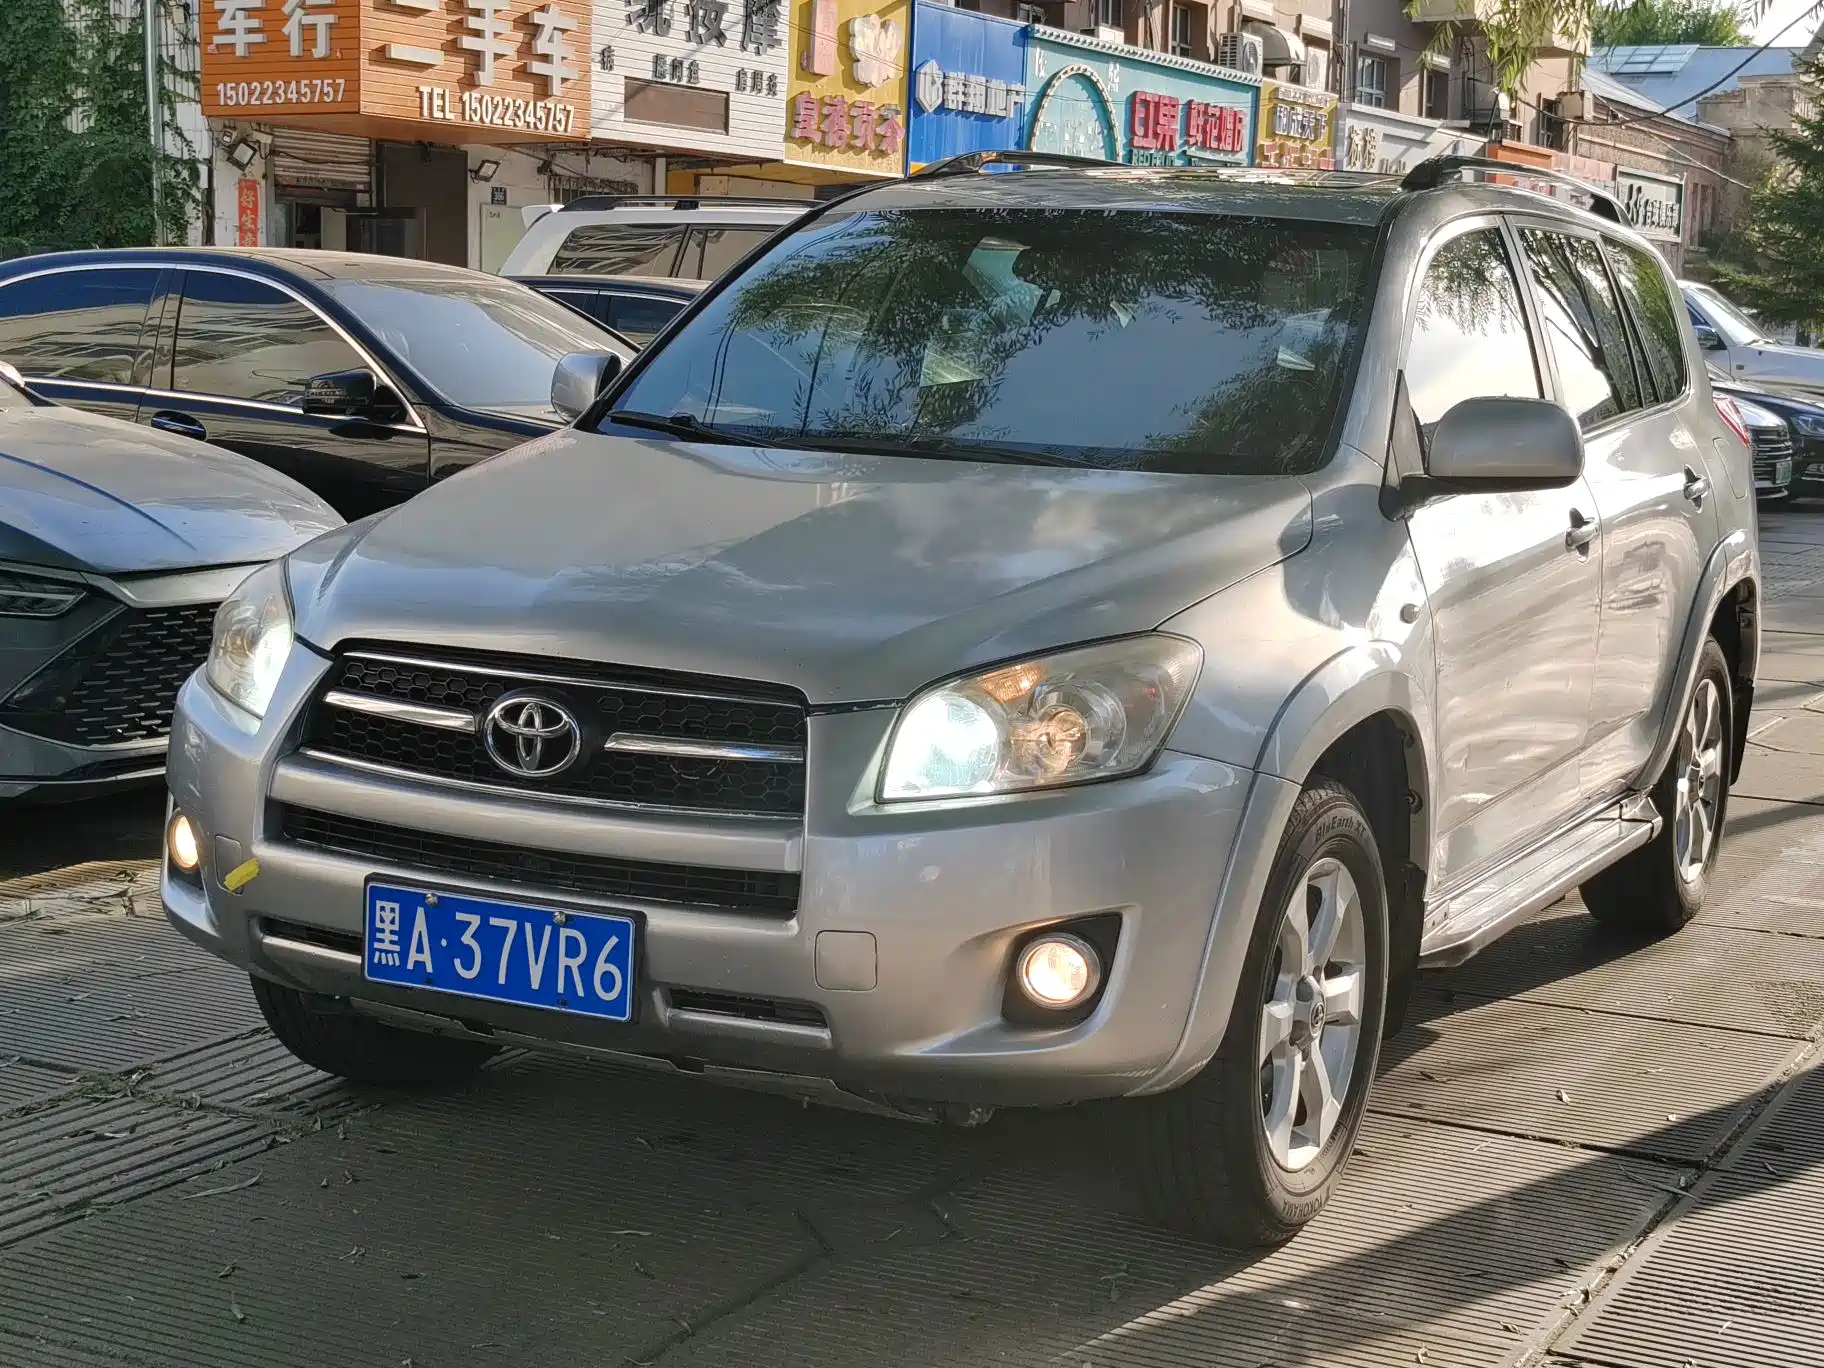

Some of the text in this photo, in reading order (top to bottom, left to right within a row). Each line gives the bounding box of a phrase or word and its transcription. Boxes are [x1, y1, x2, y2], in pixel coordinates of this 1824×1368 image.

[213, 0, 339, 58] 车行
[386, 0, 581, 96] 二手车
[217, 79, 345, 106] 15022345757
[418, 85, 575, 134] TEL 15022345757
[1132, 90, 1180, 152] 红果
[373, 899, 623, 1001] 黑A·37VR6
